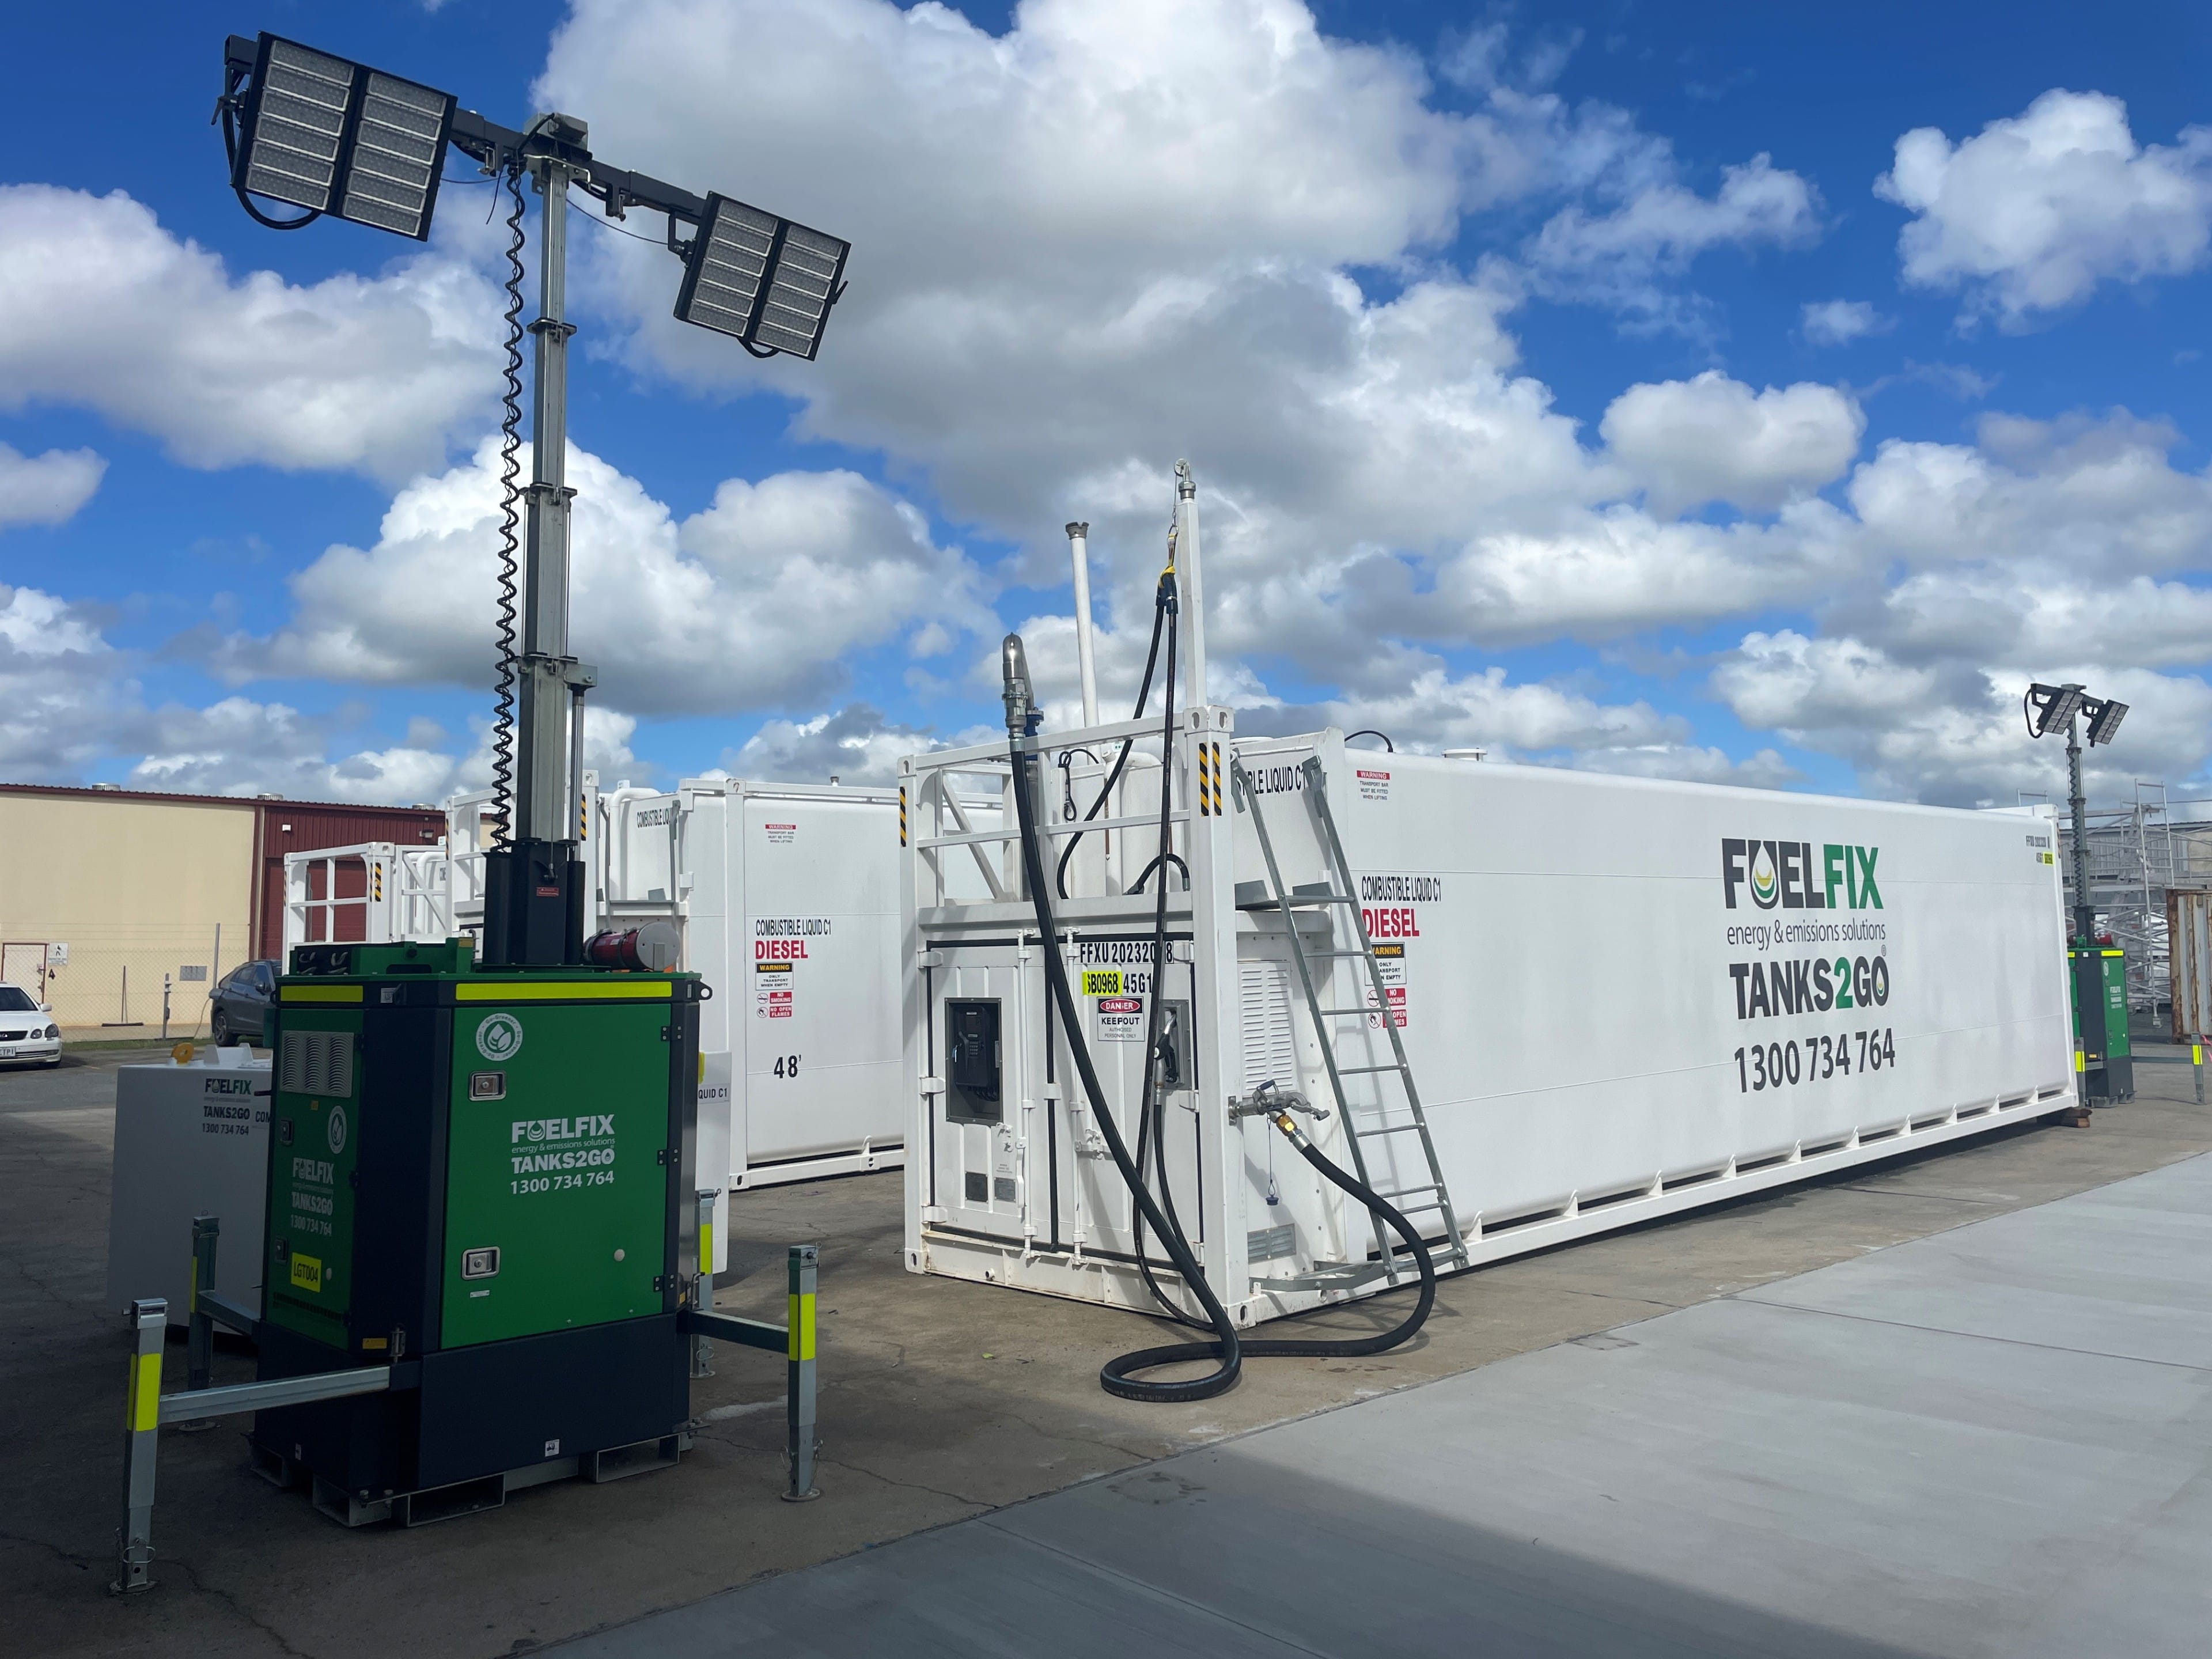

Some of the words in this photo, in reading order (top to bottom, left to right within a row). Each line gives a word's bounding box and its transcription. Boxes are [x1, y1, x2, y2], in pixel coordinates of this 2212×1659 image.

[1266, 766, 1293, 794] LIQUID
[1296, 765, 1305, 790] C1
[1360, 771, 1387, 779] WARNING
[662, 808, 673, 825] LIQU
[1722, 838, 1884, 910] FUELFIX
[1362, 876, 1411, 902] COMBUSTIBLE
[1411, 877, 1432, 903] LIQUID
[1433, 877, 1441, 902] C1
[756, 919, 801, 936] COMBUSTIBLE
[802, 919, 823, 936] LIQUID
[824, 919, 831, 935] C1
[1362, 908, 1420, 938] DIESEL
[1728, 925, 1771, 950] energy
[1774, 919, 1784, 943] &
[1786, 919, 1839, 942] emissions
[1842, 917, 1886, 941] solutions
[755, 940, 808, 959] DIESEL
[1080, 942, 1109, 963] FFXU
[48, 968, 55, 980] 4
[1123, 972, 1152, 994] 45G1
[1729, 956, 1889, 1020] TANKS2GO
[1734, 1040, 1800, 1093] 1300
[1805, 1033, 1850, 1082] 734
[1855, 1028, 1896, 1073] 764
[205, 1078, 252, 1094] FUELFIX
[699, 1088, 716, 1099] QUID
[718, 1088, 727, 1097] C1
[203, 1105, 250, 1120] TANKS2GO
[202, 1123, 219, 1134] 1300
[221, 1124, 234, 1134] 734
[236, 1125, 249, 1135] 764
[512, 1114, 615, 1143] FUELFIX
[512, 1145, 538, 1154] energy
[539, 1143, 546, 1151] &
[546, 1141, 582, 1150] emissions
[584, 1138, 615, 1147] solutions
[293, 1157, 335, 1185] FUELFIX
[511, 1148, 615, 1174] TANKS2GO
[510, 1177, 550, 1194] 1300
[554, 1174, 582, 1190] 734
[586, 1170, 615, 1186] 764
[291, 1191, 334, 1216] TANKS2GO
[290, 1214, 305, 1230] 1300
[306, 1218, 319, 1233] 734
[320, 1221, 332, 1236] 764
[294, 1262, 319, 1282] LGT004
